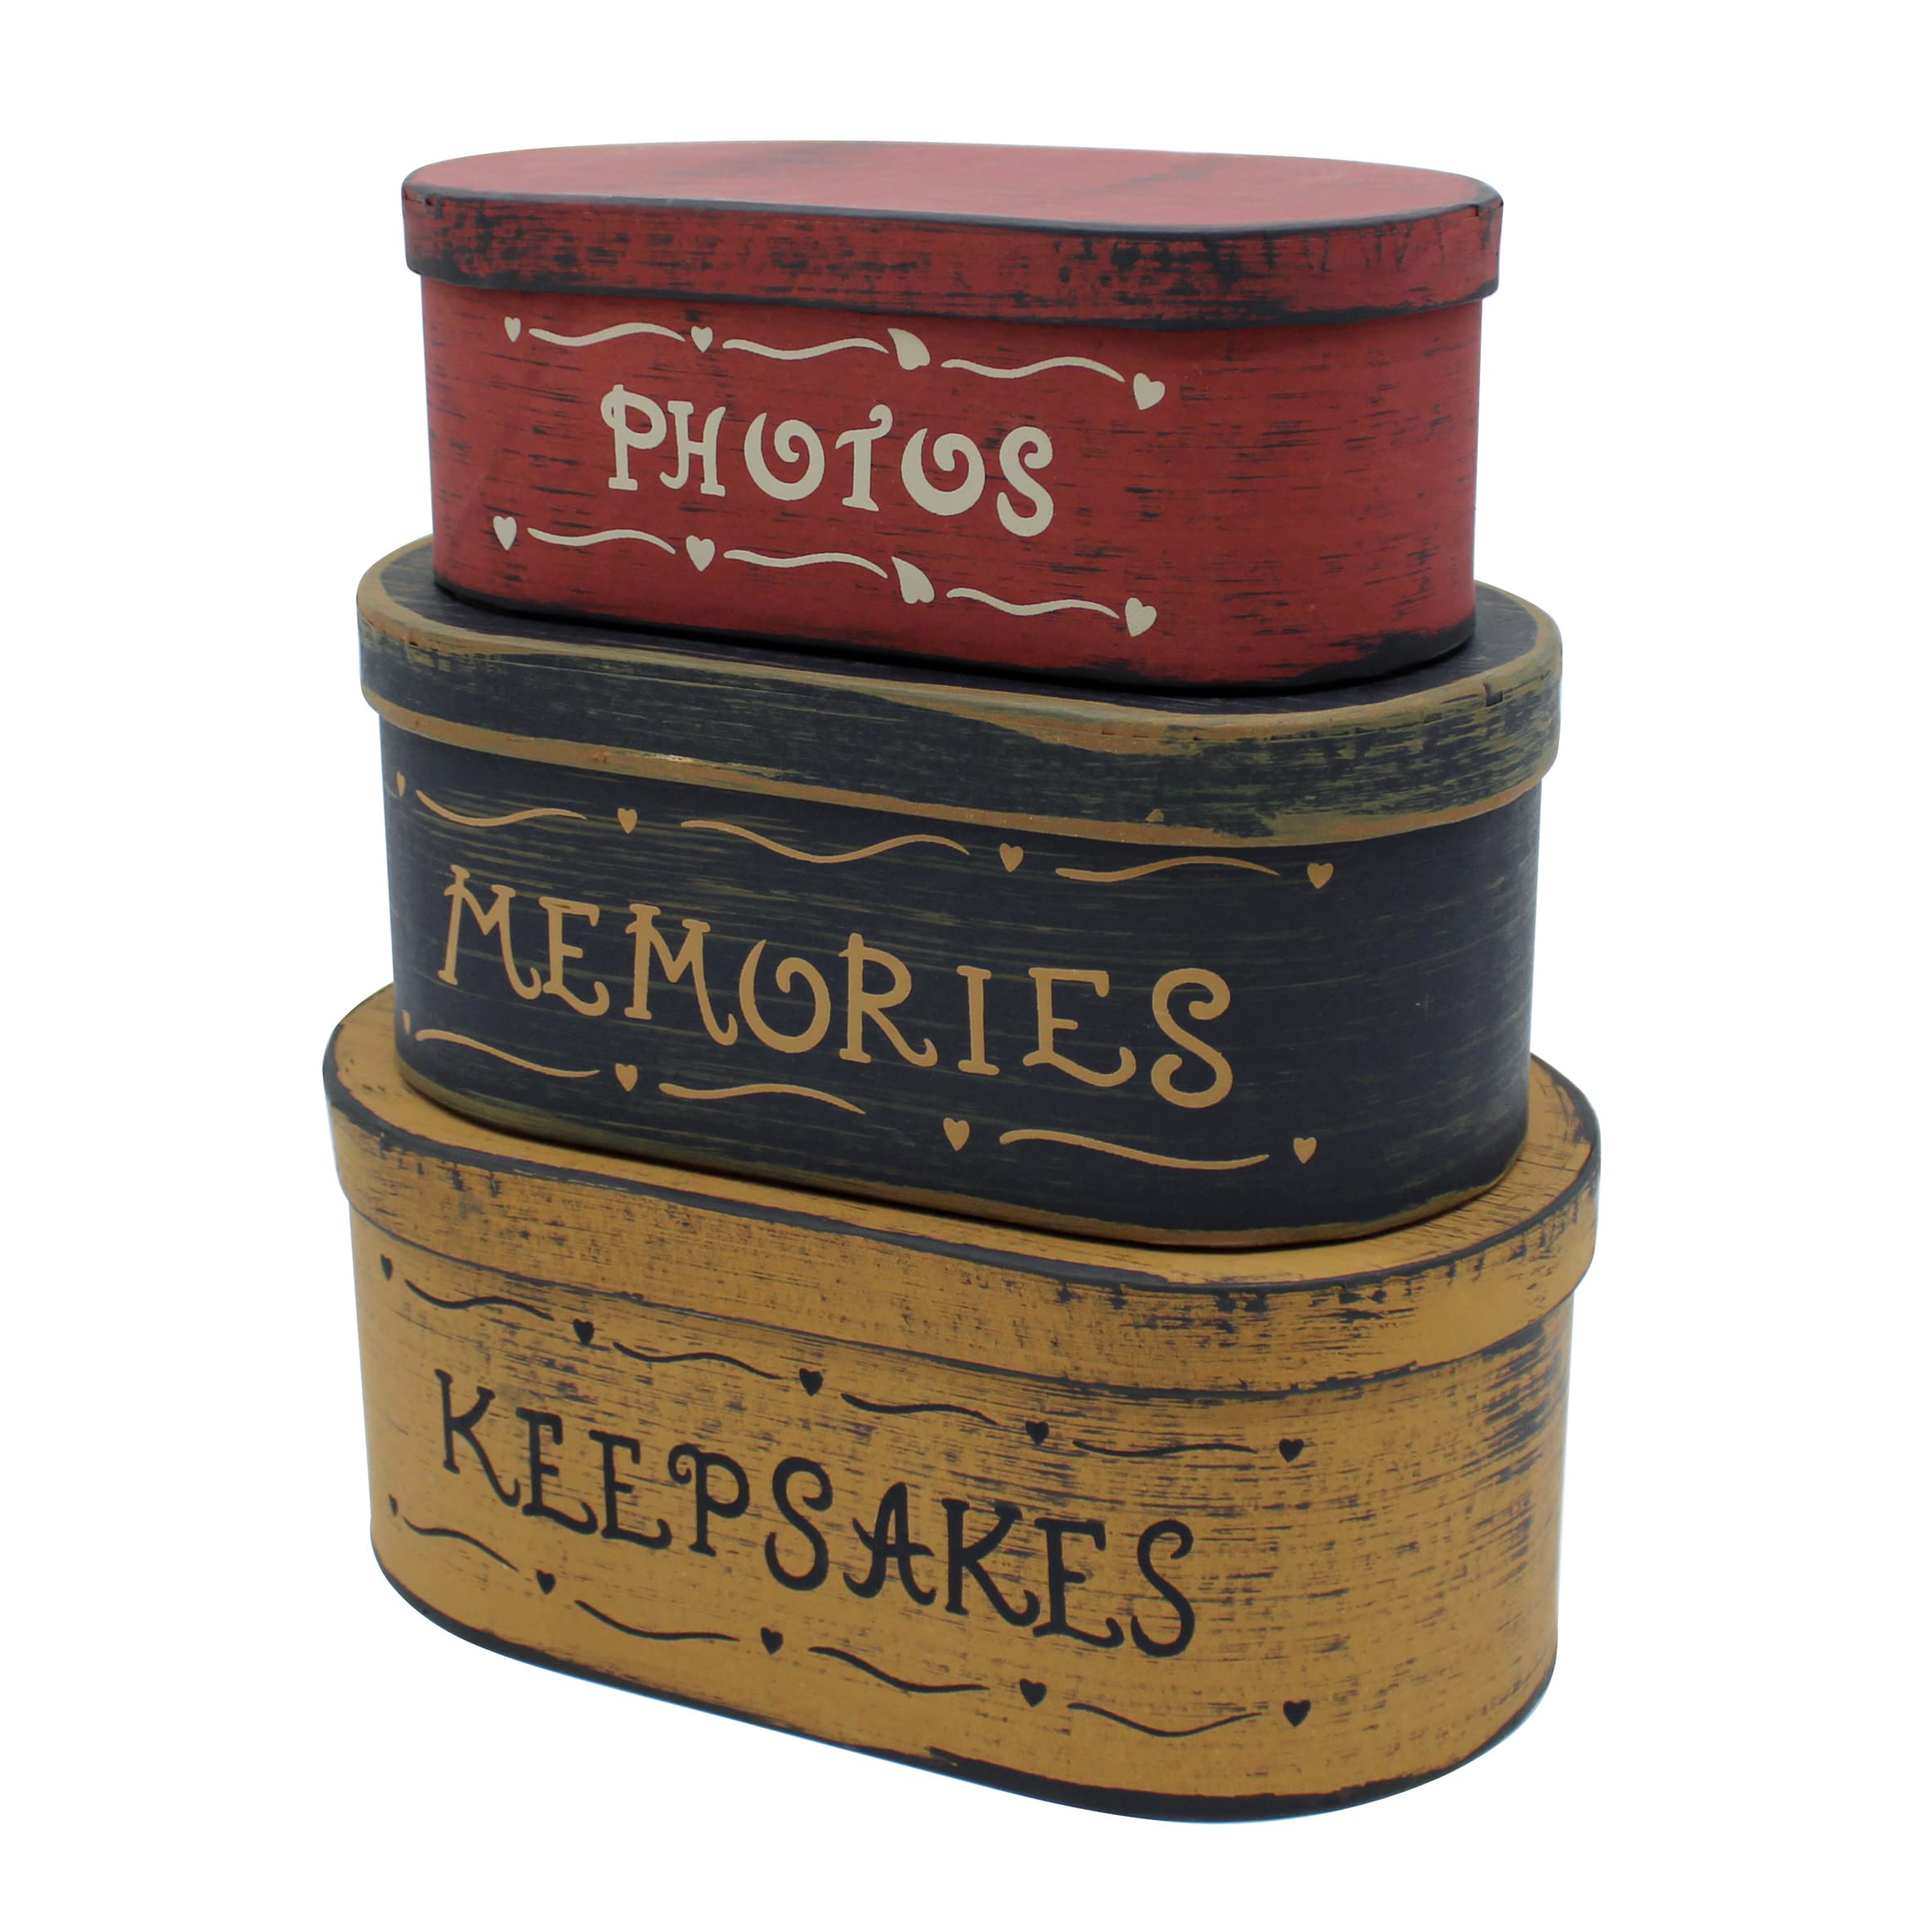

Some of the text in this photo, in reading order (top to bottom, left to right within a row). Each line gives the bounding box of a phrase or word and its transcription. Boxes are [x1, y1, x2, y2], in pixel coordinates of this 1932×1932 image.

[600, 383, 1055, 538] PHOTOS
[438, 864, 1233, 1109] MEMORIES
[435, 1369, 1197, 1659] KEEPSAKES
